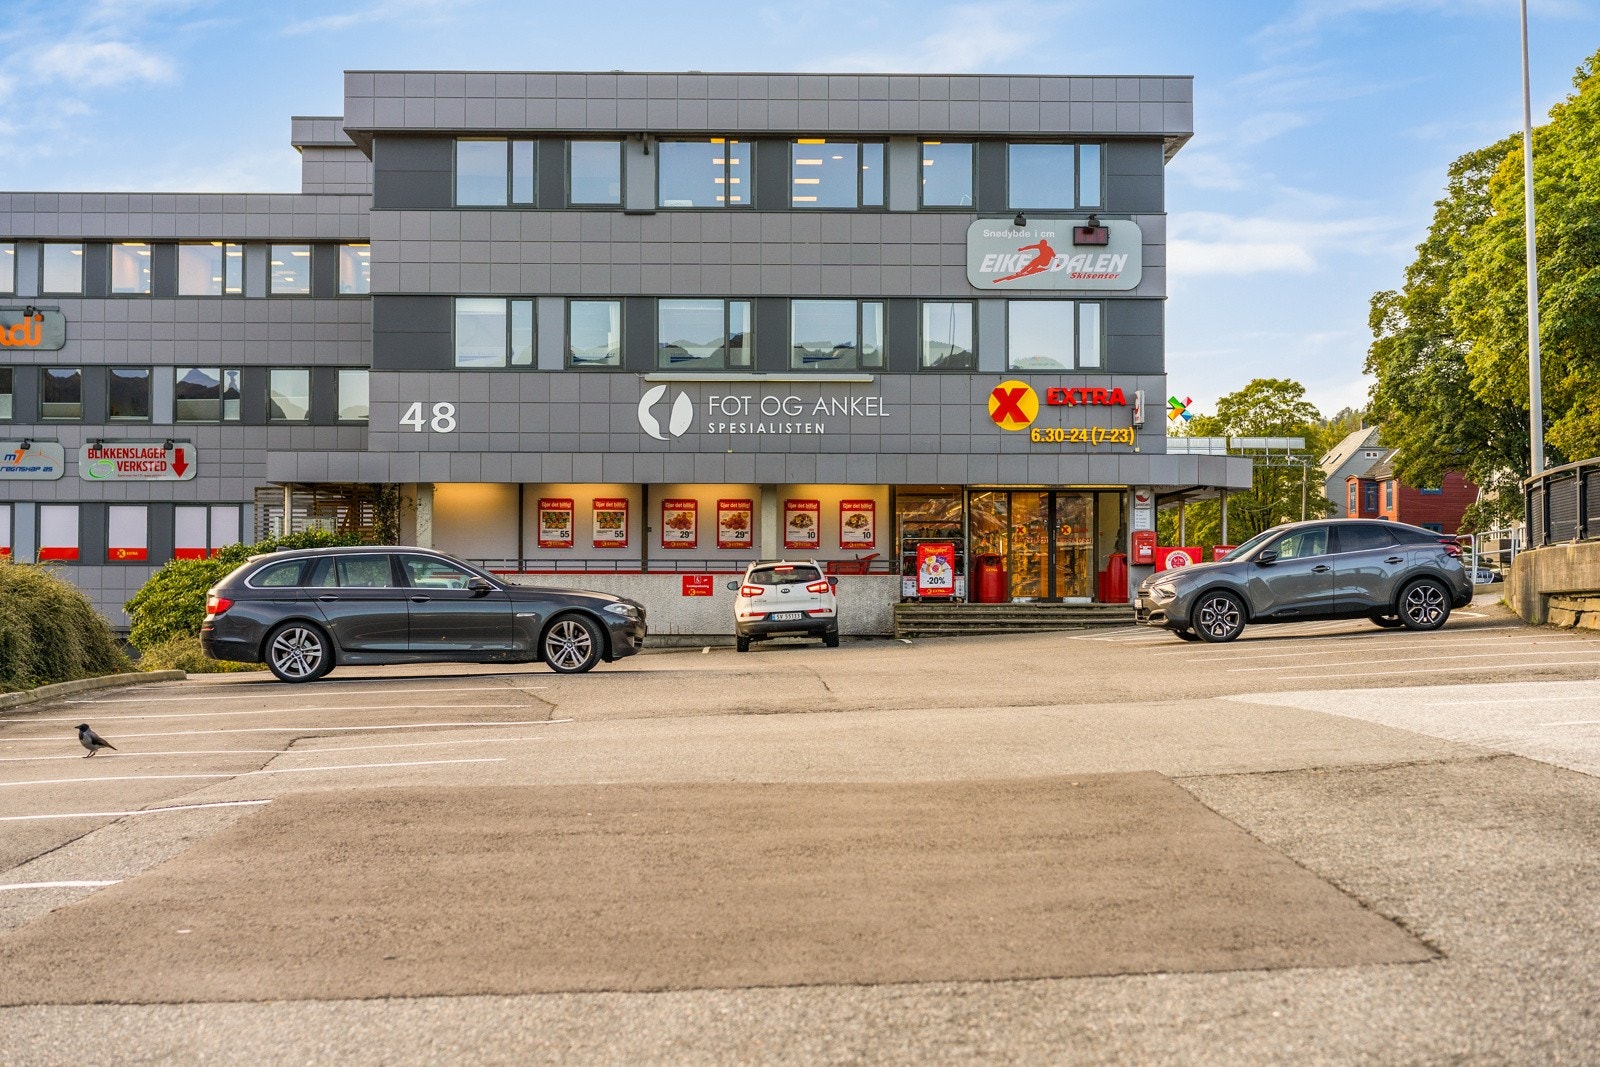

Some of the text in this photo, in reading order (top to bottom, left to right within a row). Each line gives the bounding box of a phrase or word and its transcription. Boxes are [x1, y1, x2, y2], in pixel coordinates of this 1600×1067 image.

[1070, 272, 1120, 280] Skisenter
[1046, 387, 1126, 406] EXTRA
[709, 395, 890, 417] FOT OG ANKEL
[399, 401, 456, 433] 48
[708, 422, 825, 434] SPESIALISTEN
[1031, 426, 1135, 446] 6.30-24 (7-23)
[87, 447, 166, 460] BLIKKENSLAGER
[117, 460, 167, 472] VERKSTED
[560, 530, 570, 538] 55
[614, 530, 624, 538] 55
[807, 531, 816, 539] 10
[862, 531, 871, 539] 10
[926, 576, 946, 585] -20%
